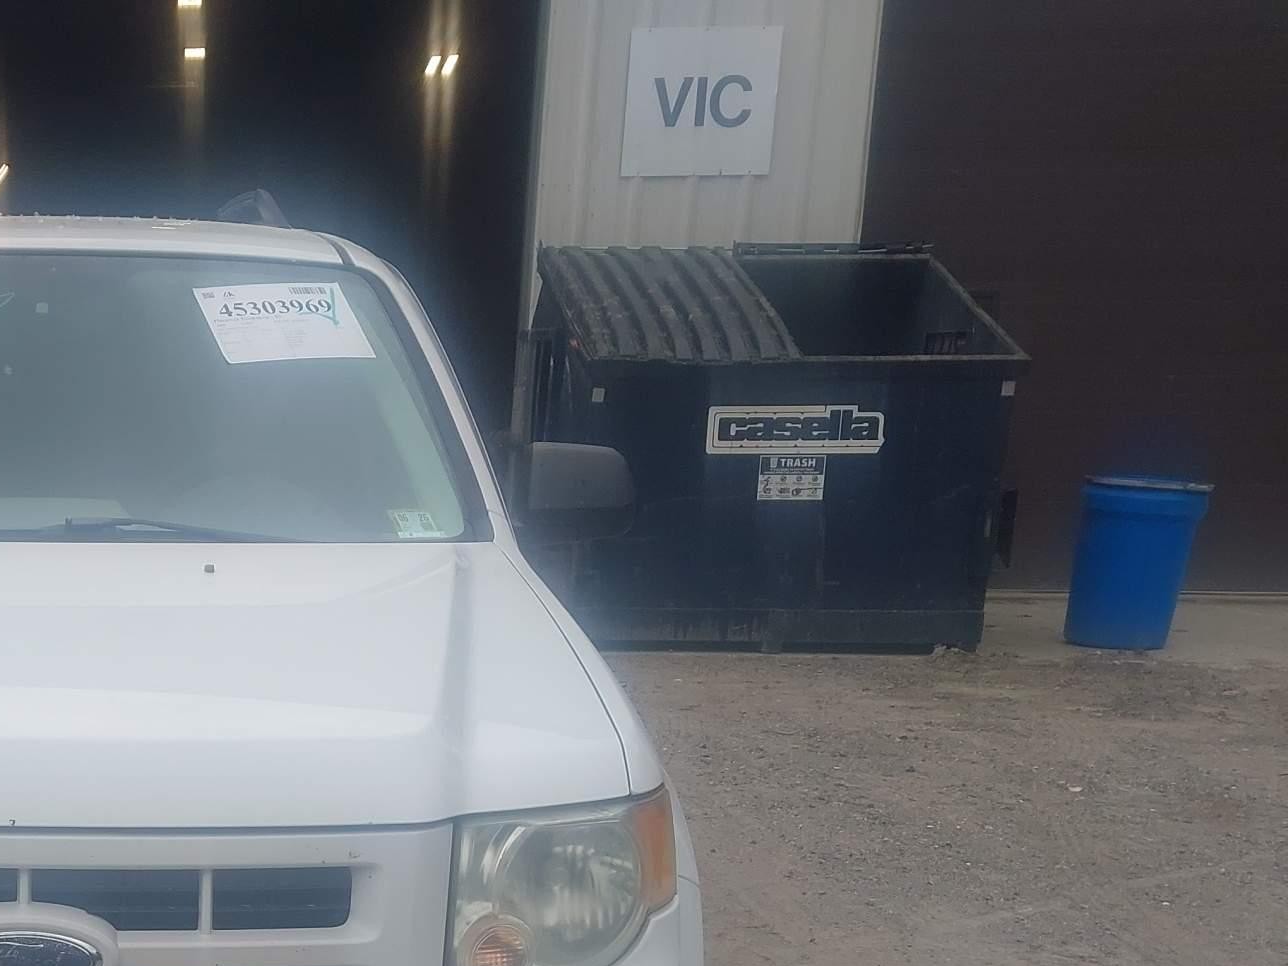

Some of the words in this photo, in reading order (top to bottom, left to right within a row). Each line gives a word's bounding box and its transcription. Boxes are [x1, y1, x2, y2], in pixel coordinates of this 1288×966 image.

[654, 74, 753, 128] VIC
[219, 299, 332, 317] 45303969
[718, 409, 880, 442] casella
[779, 457, 817, 468] TRASH
